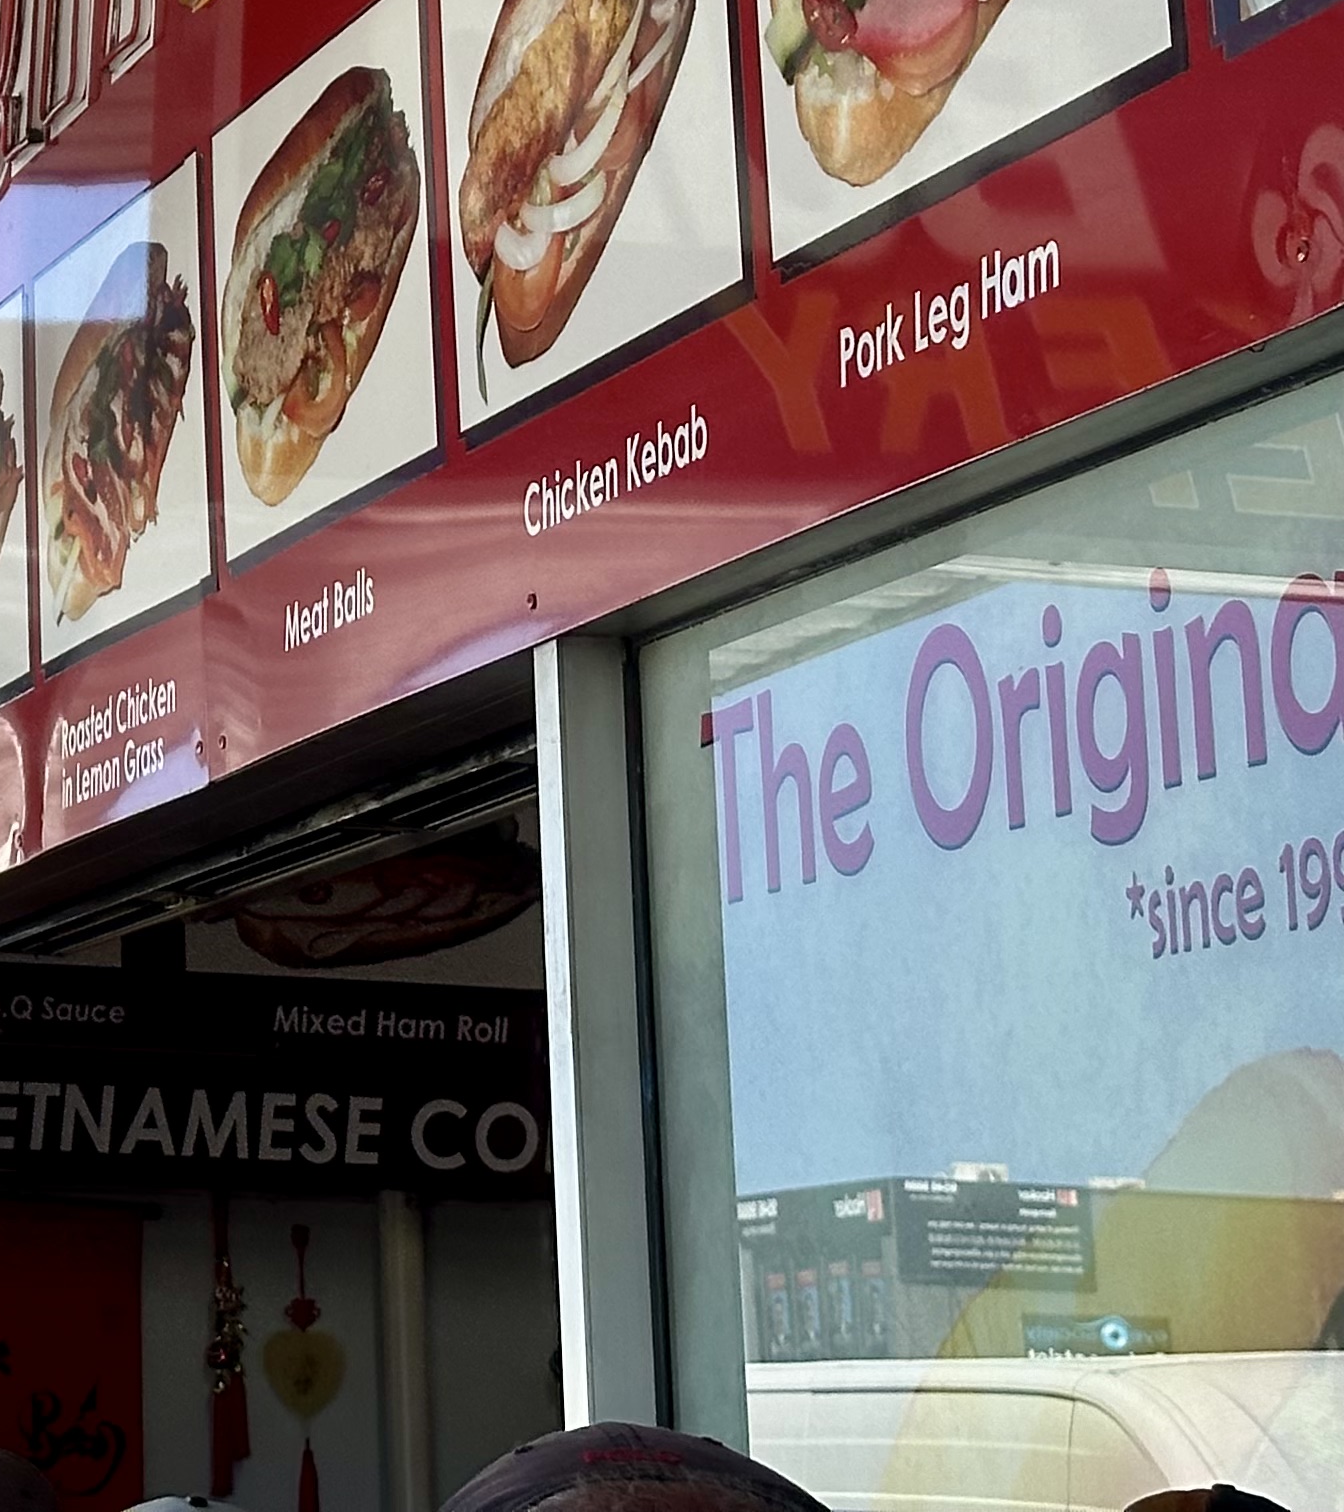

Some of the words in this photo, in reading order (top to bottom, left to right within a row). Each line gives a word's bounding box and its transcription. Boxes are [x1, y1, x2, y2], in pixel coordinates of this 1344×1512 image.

[838, 302, 906, 388] Pork
[914, 278, 971, 355] Leg
[980, 236, 1061, 316] Ham
[522, 455, 620, 537] Chicken
[625, 404, 709, 491] Kebab
[283, 586, 328, 652] Meat
[333, 567, 374, 629] Balls
[60, 706, 113, 760] Roasted
[116, 677, 176, 734] Chicken
[60, 769, 73, 809] in
[76, 761, 121, 804] Lemon
[124, 737, 164, 785] Grass
[701, 689, 874, 904] The
[41, 995, 126, 1024] Sauce
[273, 1005, 366, 1037] Mixed
[377, 1011, 445, 1041] Ham
[457, 1014, 509, 1044] Roll
